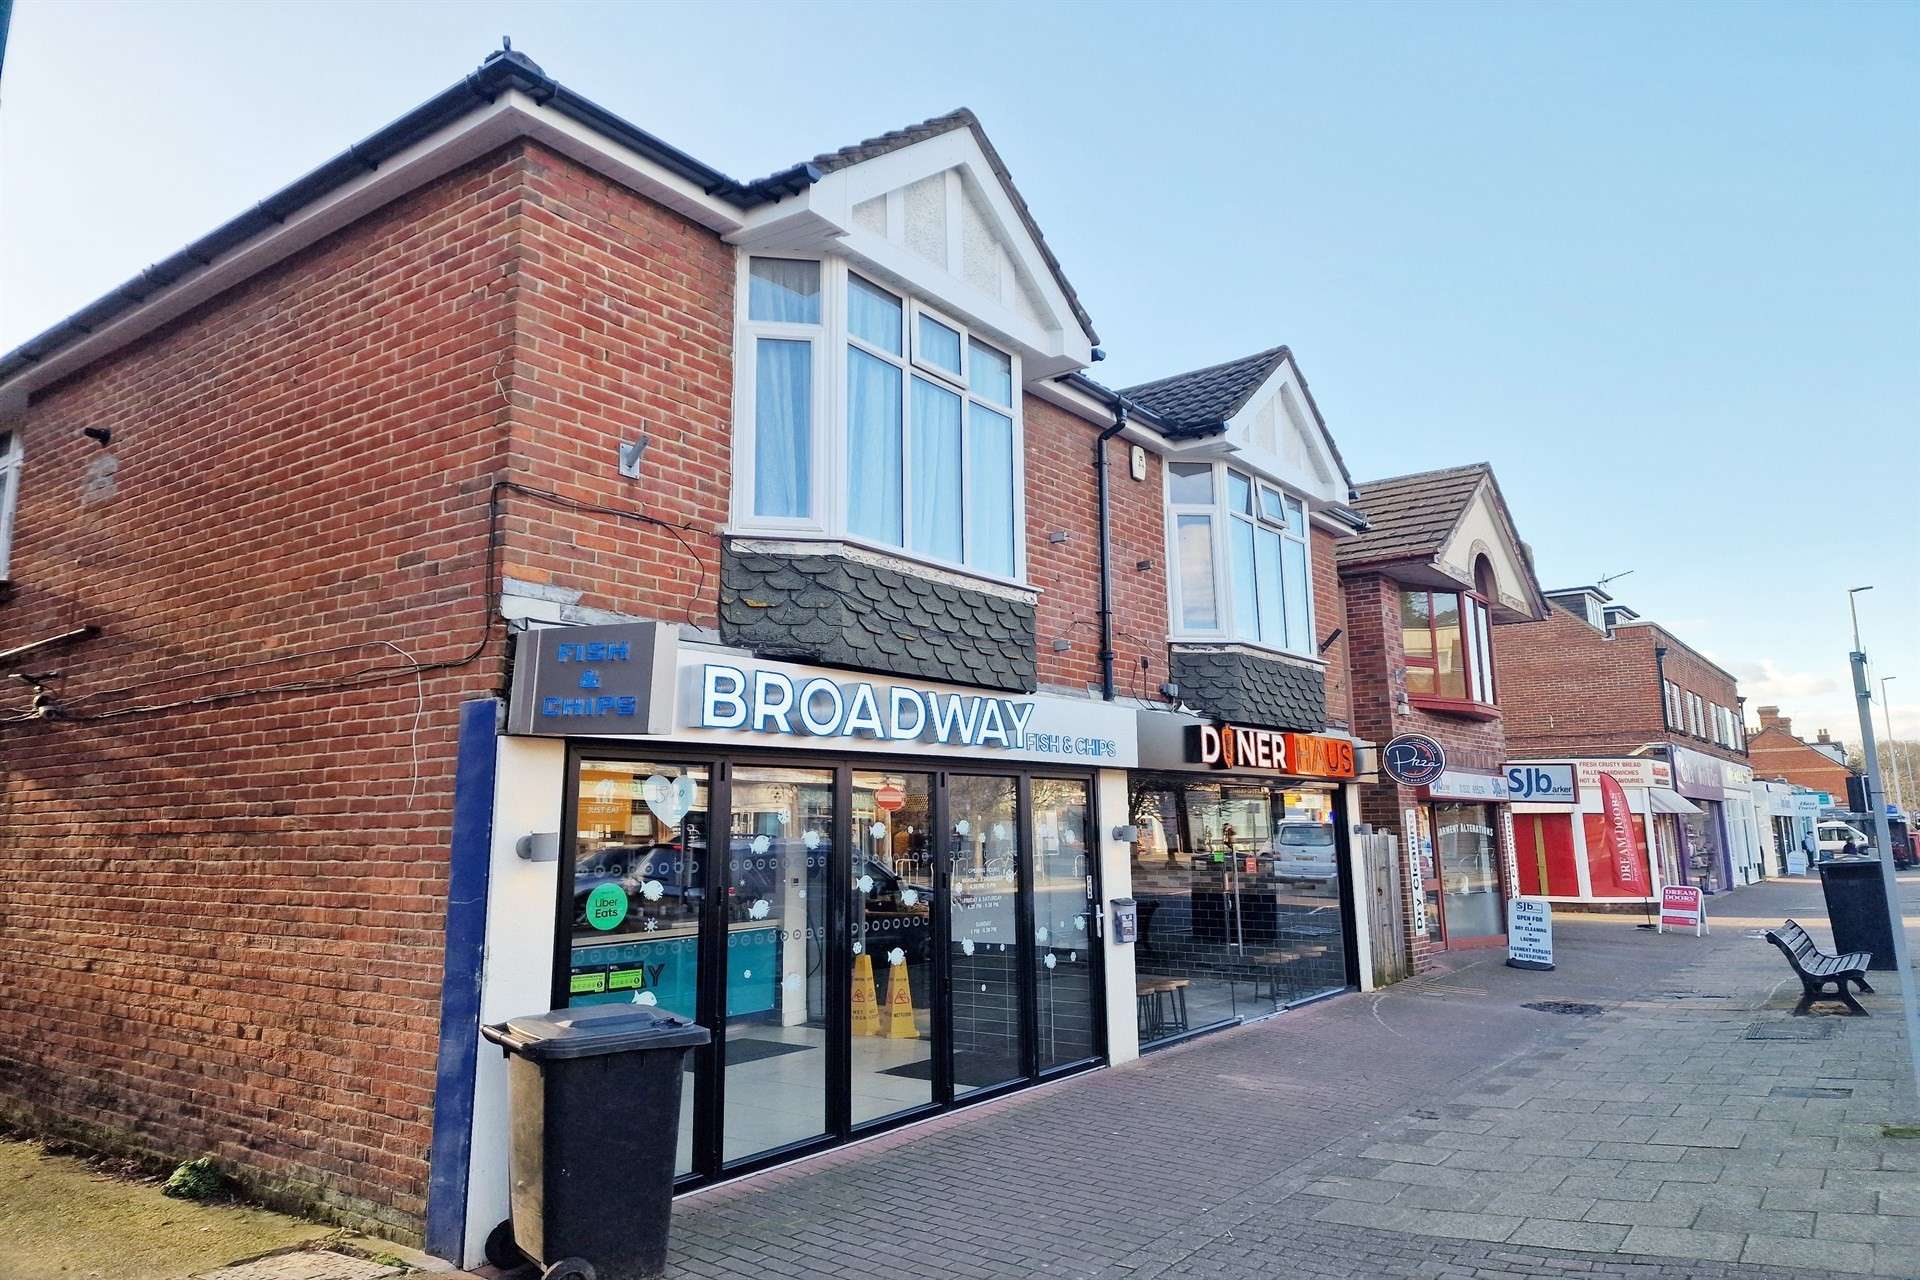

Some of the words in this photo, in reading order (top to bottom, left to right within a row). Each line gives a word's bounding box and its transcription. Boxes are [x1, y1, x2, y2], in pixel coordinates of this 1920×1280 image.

[557, 641, 629, 663] FISH
[579, 669, 601, 689] &
[543, 696, 637, 718] CHIPS
[702, 664, 1034, 748] BROADWAY
[1026, 732, 1060, 753] FISH
[1062, 736, 1072, 753] &
[1075, 737, 1116, 757] CHIPS
[1609, 792, 1625, 834] DOORS
[1616, 836, 1632, 881] DREAM
[595, 898, 617, 908] Uber
[595, 908, 618, 918] Eats
[1416, 898, 1424, 930] Dry
[1517, 914, 1531, 922] OPEN
